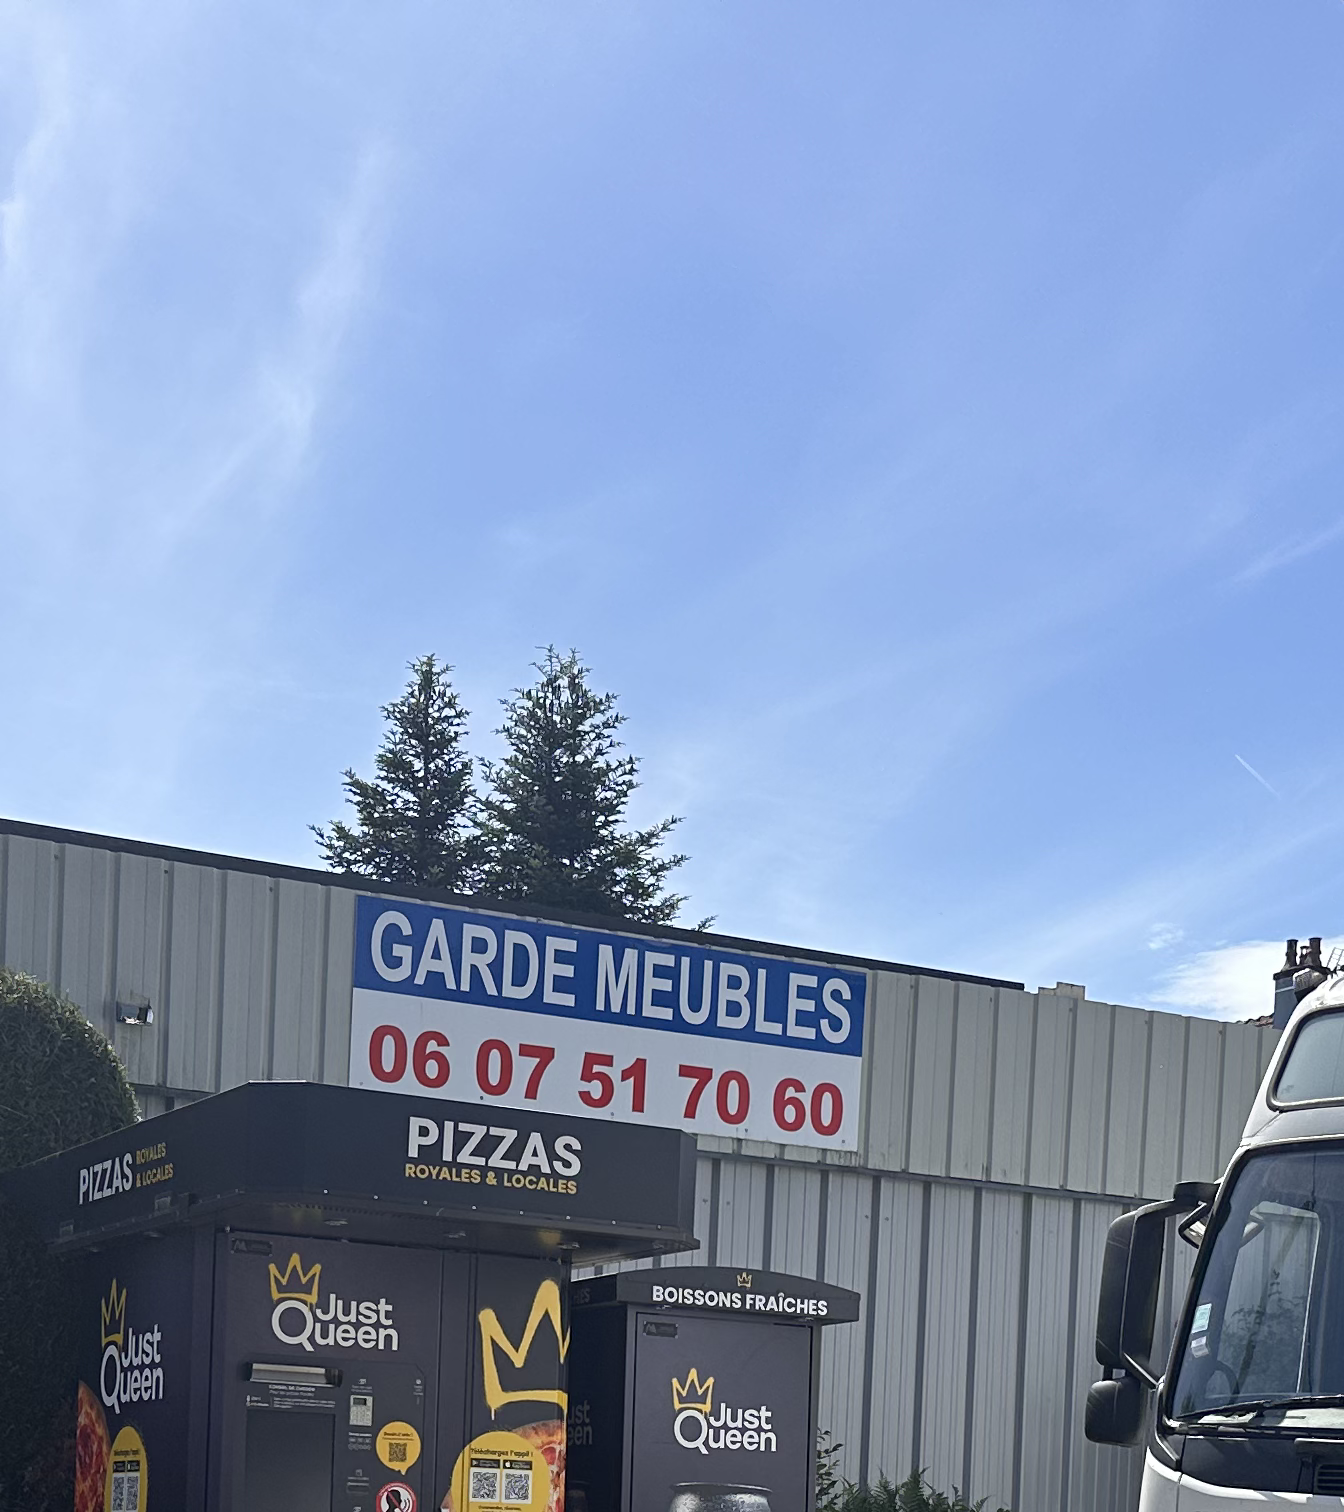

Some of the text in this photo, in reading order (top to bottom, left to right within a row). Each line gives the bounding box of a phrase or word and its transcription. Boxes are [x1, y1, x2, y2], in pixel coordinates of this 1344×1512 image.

[370, 910, 853, 1044] GARDE MEUBLES
[369, 1025, 844, 1137] 06 07 51 70 60
[136, 1142, 166, 1165] ROYALES
[407, 1116, 583, 1178] PIZZAS
[79, 1152, 133, 1205] PIZZAS
[143, 1163, 174, 1186] LOCALES
[405, 1163, 578, 1196] ROYALES & LOCALES
[316, 1293, 393, 1326] Just
[652, 1285, 829, 1317] BOISSONS FRAÎCHES
[121, 1323, 162, 1368] Just
[271, 1300, 399, 1352] Queen
[100, 1345, 164, 1414] Queen
[568, 1400, 591, 1425] ust
[673, 1409, 777, 1454] Queen
[708, 1402, 773, 1431] Just
